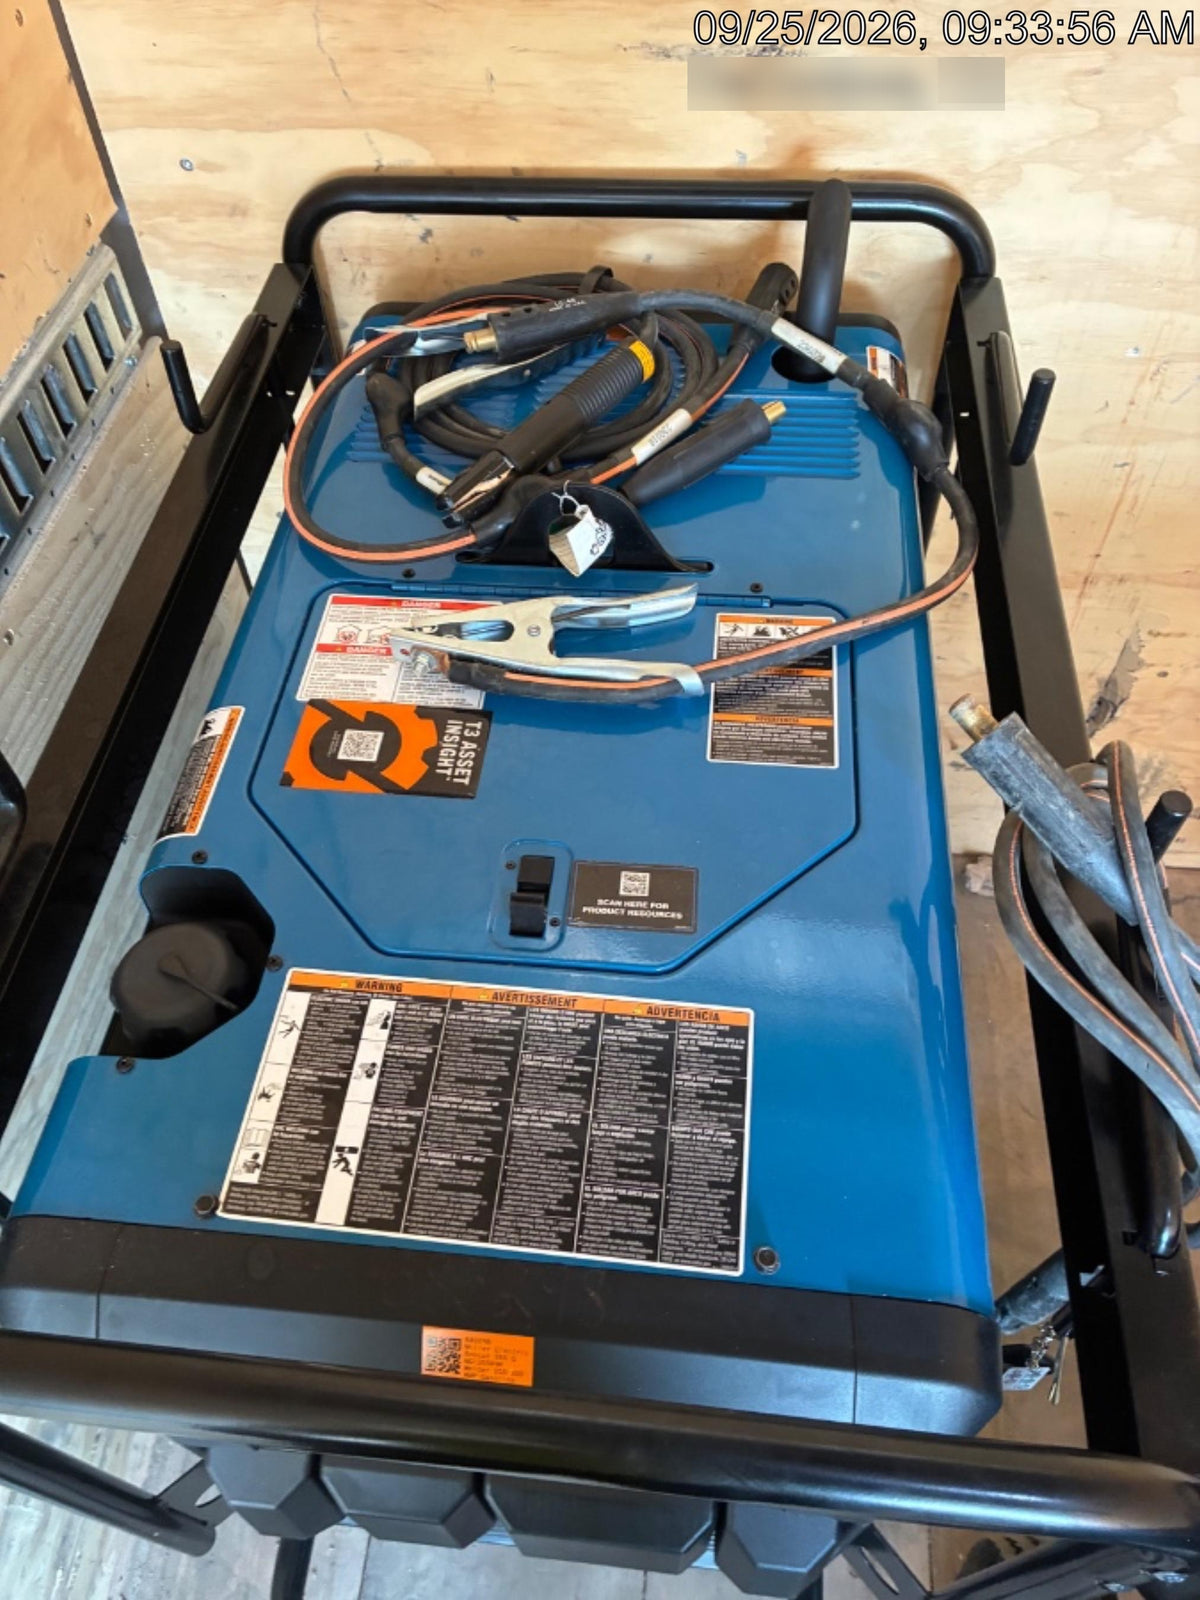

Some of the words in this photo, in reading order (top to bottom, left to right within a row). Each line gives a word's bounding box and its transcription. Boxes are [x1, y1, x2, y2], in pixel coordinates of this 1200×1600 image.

[463, 721, 482, 737] T3
[435, 719, 464, 778] INSIGHT
[453, 740, 478, 786] ASSET
[582, 906, 625, 916] PRODUCT
[627, 909, 683, 919] RESOURCES
[597, 899, 622, 907] SCAN
[624, 901, 648, 909] HERE
[650, 902, 669, 910] FOR
[356, 980, 403, 993] WARNING
[492, 991, 578, 1008] AVERTISSEMENT
[646, 1006, 720, 1022] ADVERTENCIA
